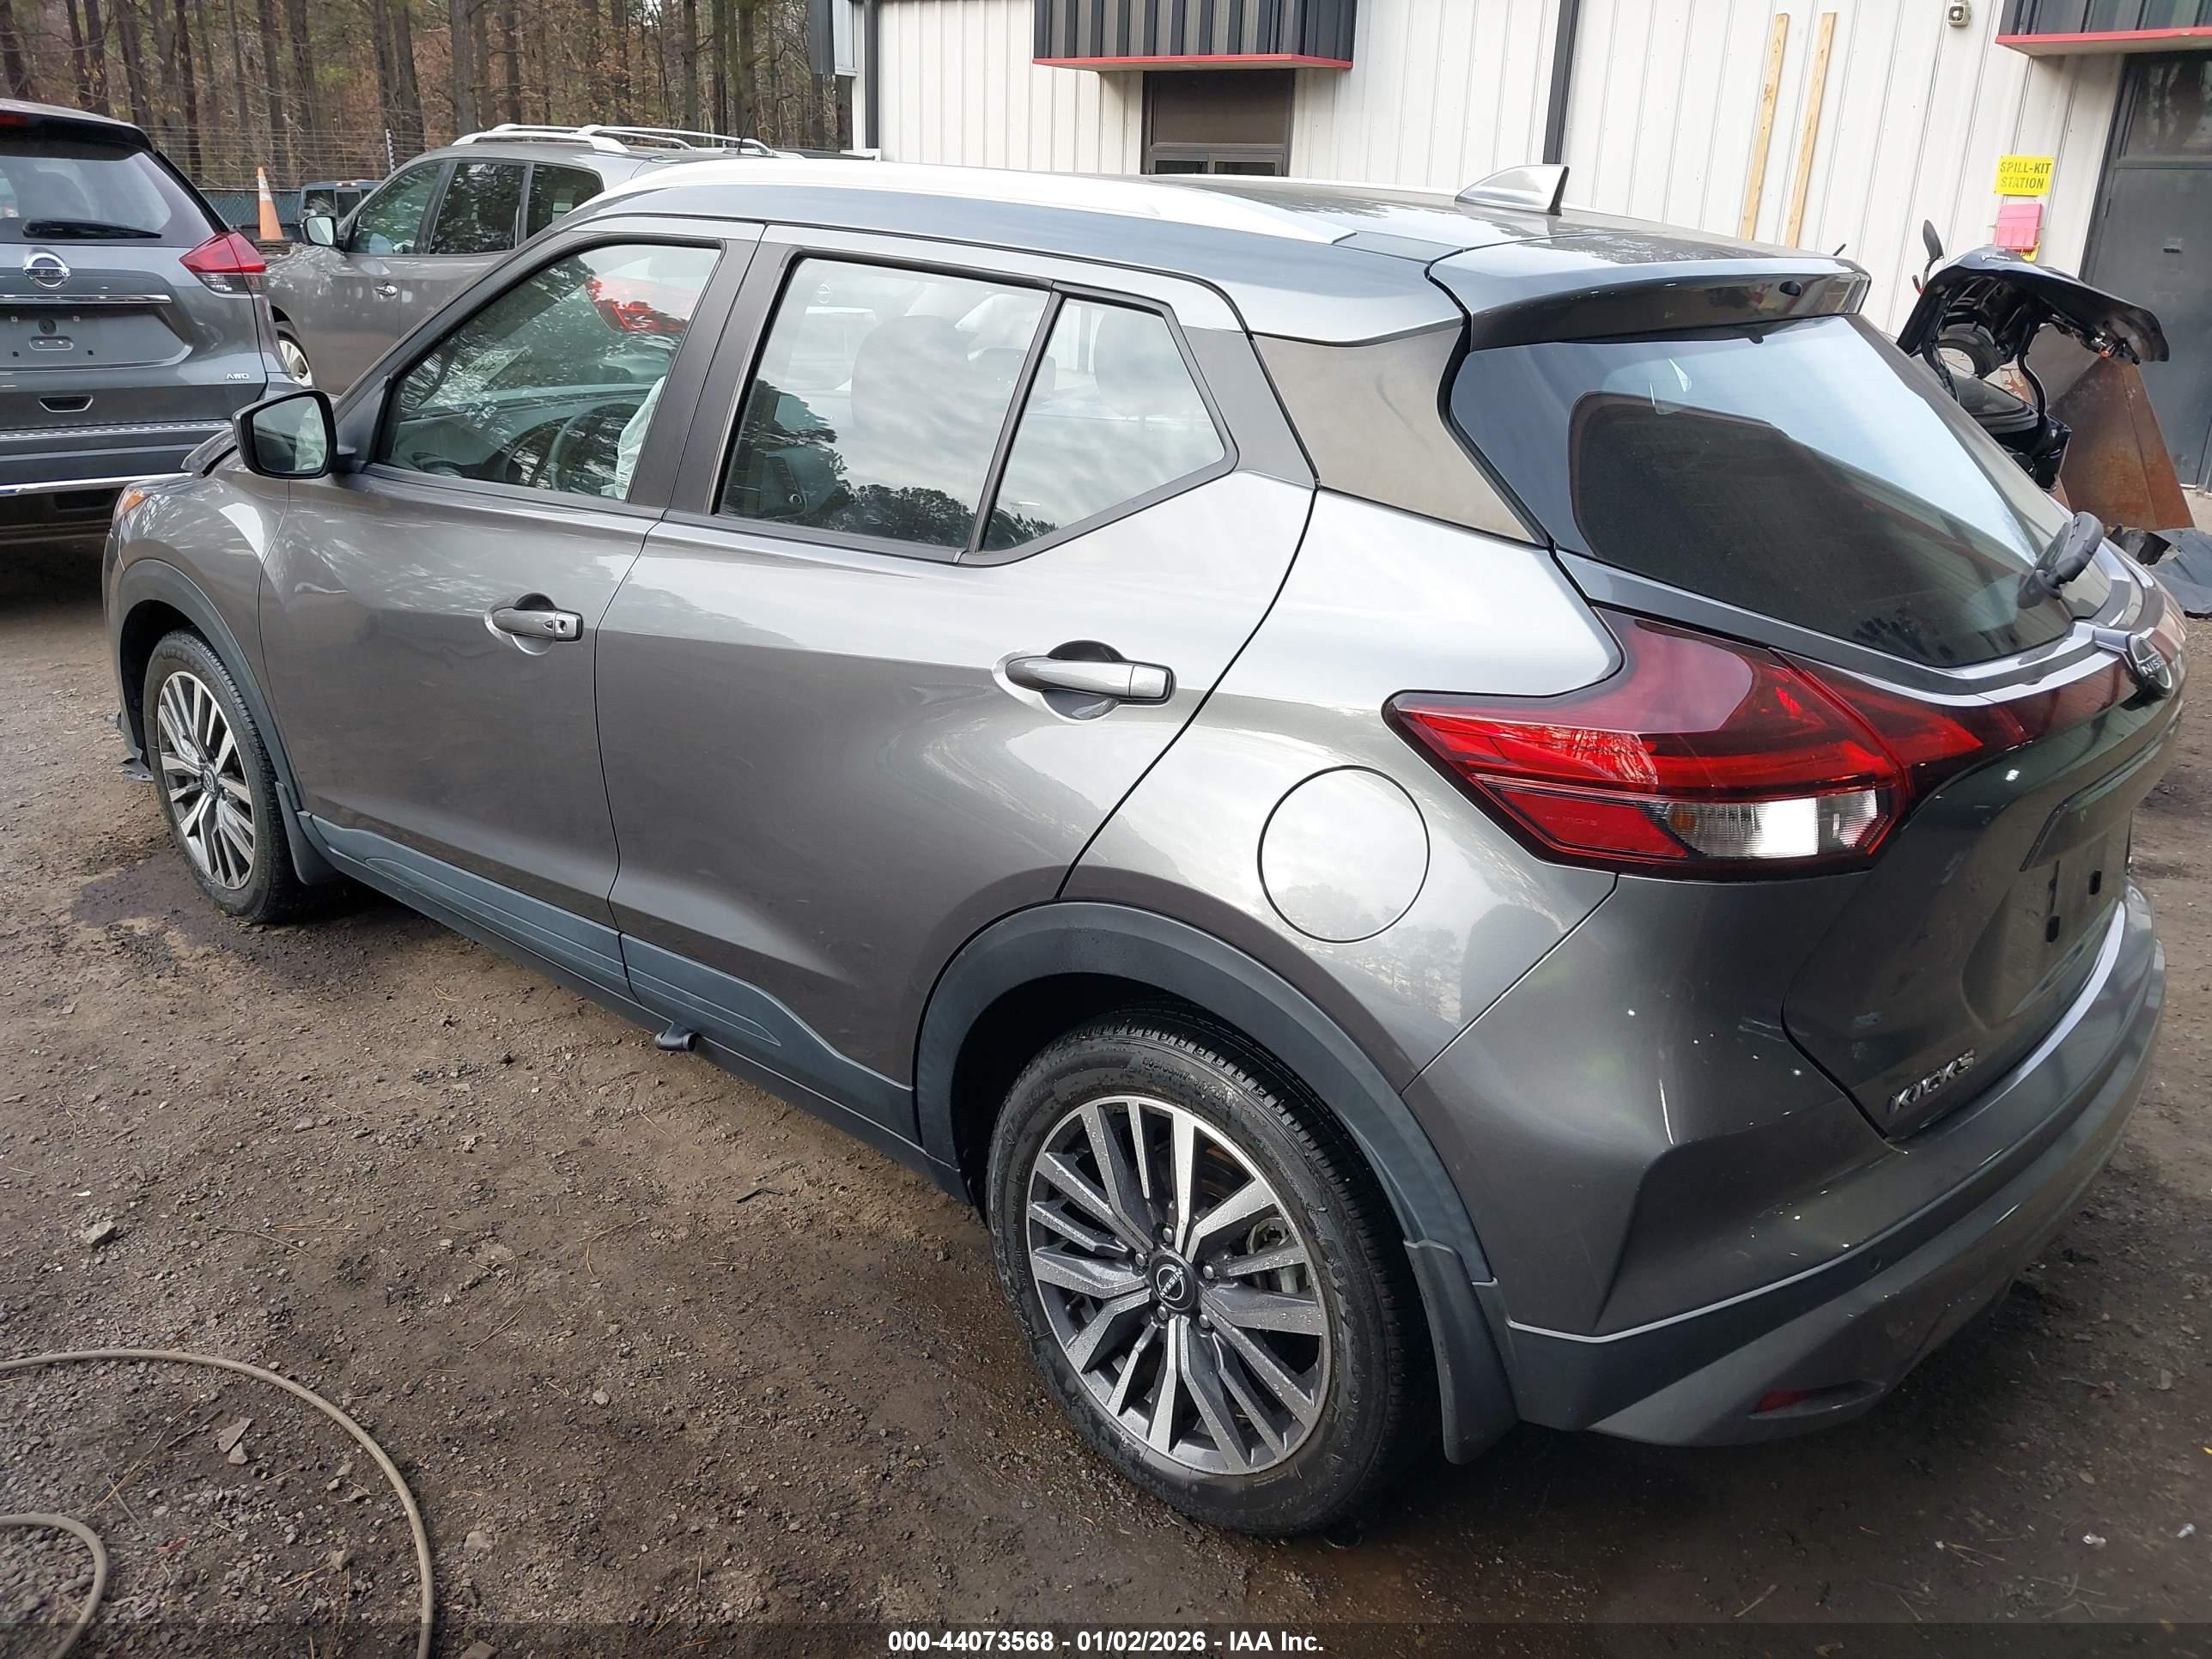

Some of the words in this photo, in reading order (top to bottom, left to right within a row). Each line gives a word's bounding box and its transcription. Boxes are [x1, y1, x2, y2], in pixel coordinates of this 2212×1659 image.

[1999, 161, 2052, 174] SPILL-KIT
[2000, 175, 2045, 190] STATION
[1887, 1048, 1974, 1114] KICKS
[1159, 1267, 1183, 1298] NISSAN
